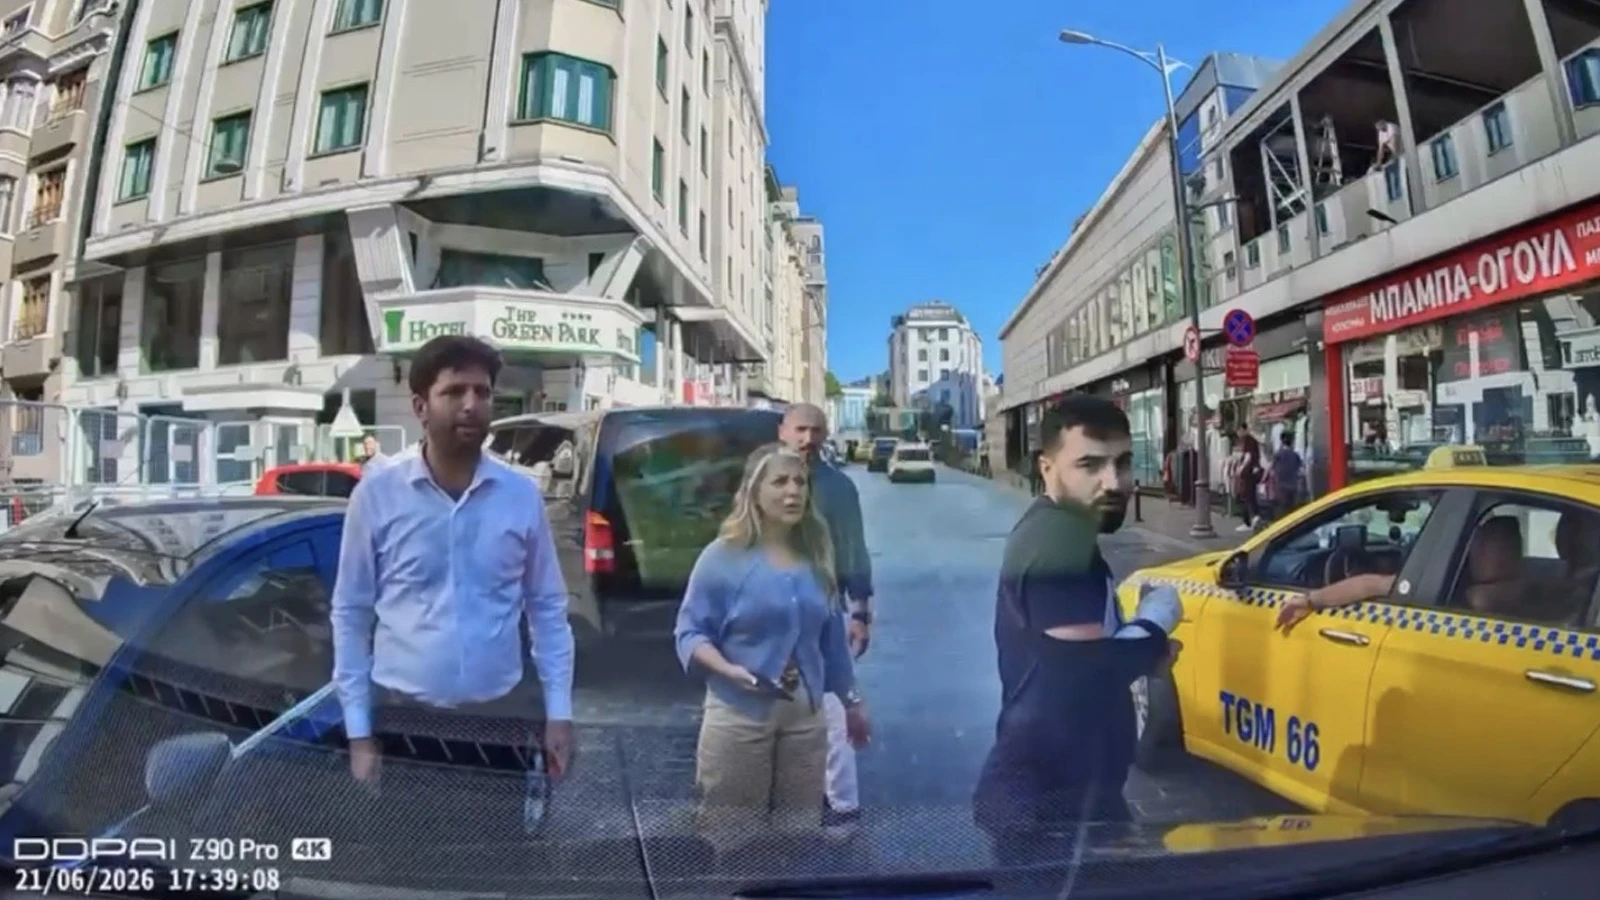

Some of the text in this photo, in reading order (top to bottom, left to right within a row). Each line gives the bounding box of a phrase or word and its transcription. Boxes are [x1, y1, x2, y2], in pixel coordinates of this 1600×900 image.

[491, 317, 554, 343] GREEN
[558, 321, 602, 346] PARK
[1219, 690, 1320, 771] TGM 66
